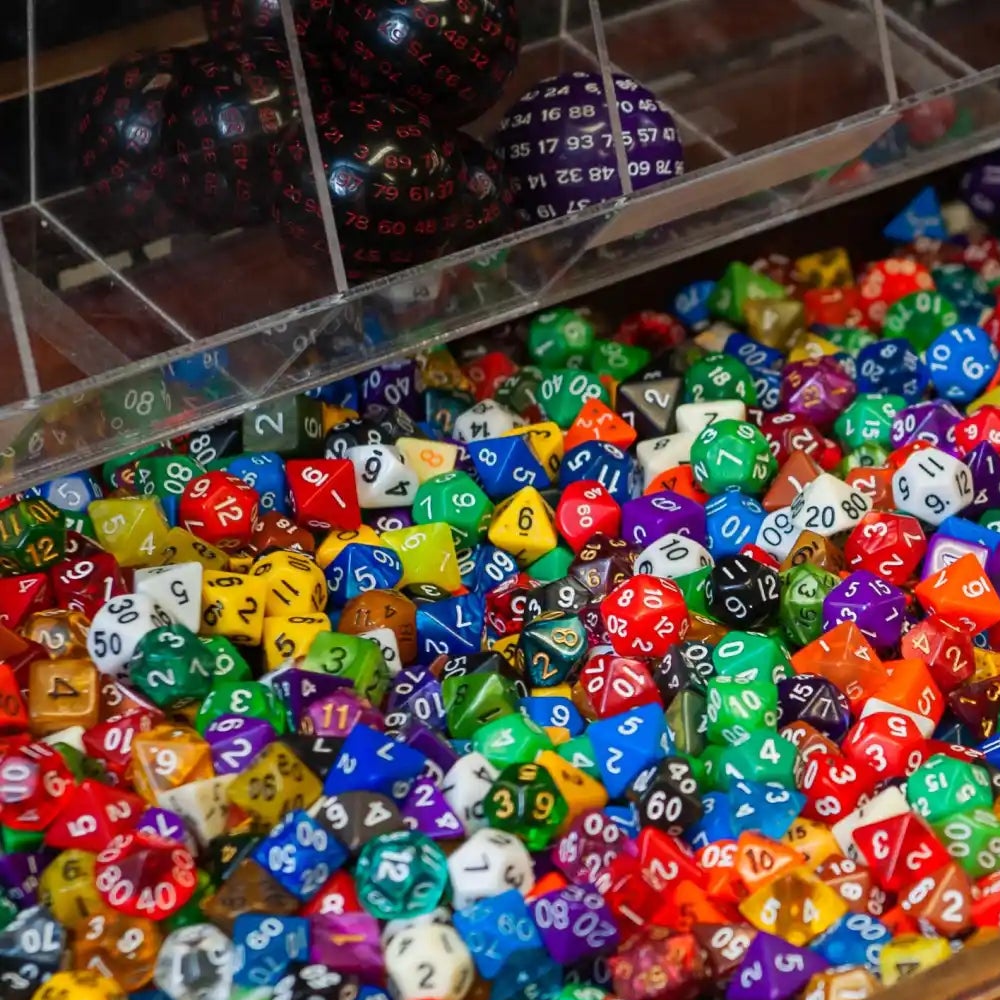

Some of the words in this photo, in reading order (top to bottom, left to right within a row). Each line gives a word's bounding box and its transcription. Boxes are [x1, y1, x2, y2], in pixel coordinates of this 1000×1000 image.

[542, 108, 561, 121] 16
[569, 105, 595, 117] 88
[510, 143, 530, 158] 35
[538, 139, 559, 154] 17
[567, 136, 594, 149] 93
[637, 128, 657, 142] 57
[373, 183, 399, 200] 79
[255, 412, 283, 435] 2
[893, 415, 915, 441] 30
[420, 449, 443, 467] 8
[479, 448, 497, 465] 8
[717, 449, 742, 467] 7
[919, 457, 944, 477] 11
[955, 471, 971, 496] 12
[213, 495, 243, 527] 12
[805, 506, 835, 528] 20
[842, 493, 867, 519] 80
[26, 537, 58, 566] 12
[660, 538, 688, 561] 10
[355, 566, 377, 591] 5
[758, 576, 778, 602] 12
[109, 599, 138, 624] 30
[94, 631, 122, 657] 50
[553, 629, 578, 646] 8
[534, 652, 558, 679] 2
[323, 703, 348, 728] 11
[729, 690, 762, 717] 10
[221, 739, 252, 767] 2
[759, 740, 780, 764] 4
[415, 785, 435, 808] 2
[493, 790, 514, 818] 3
[746, 849, 774, 871] 10
[942, 891, 963, 921] 2
[417, 964, 435, 988] 2
